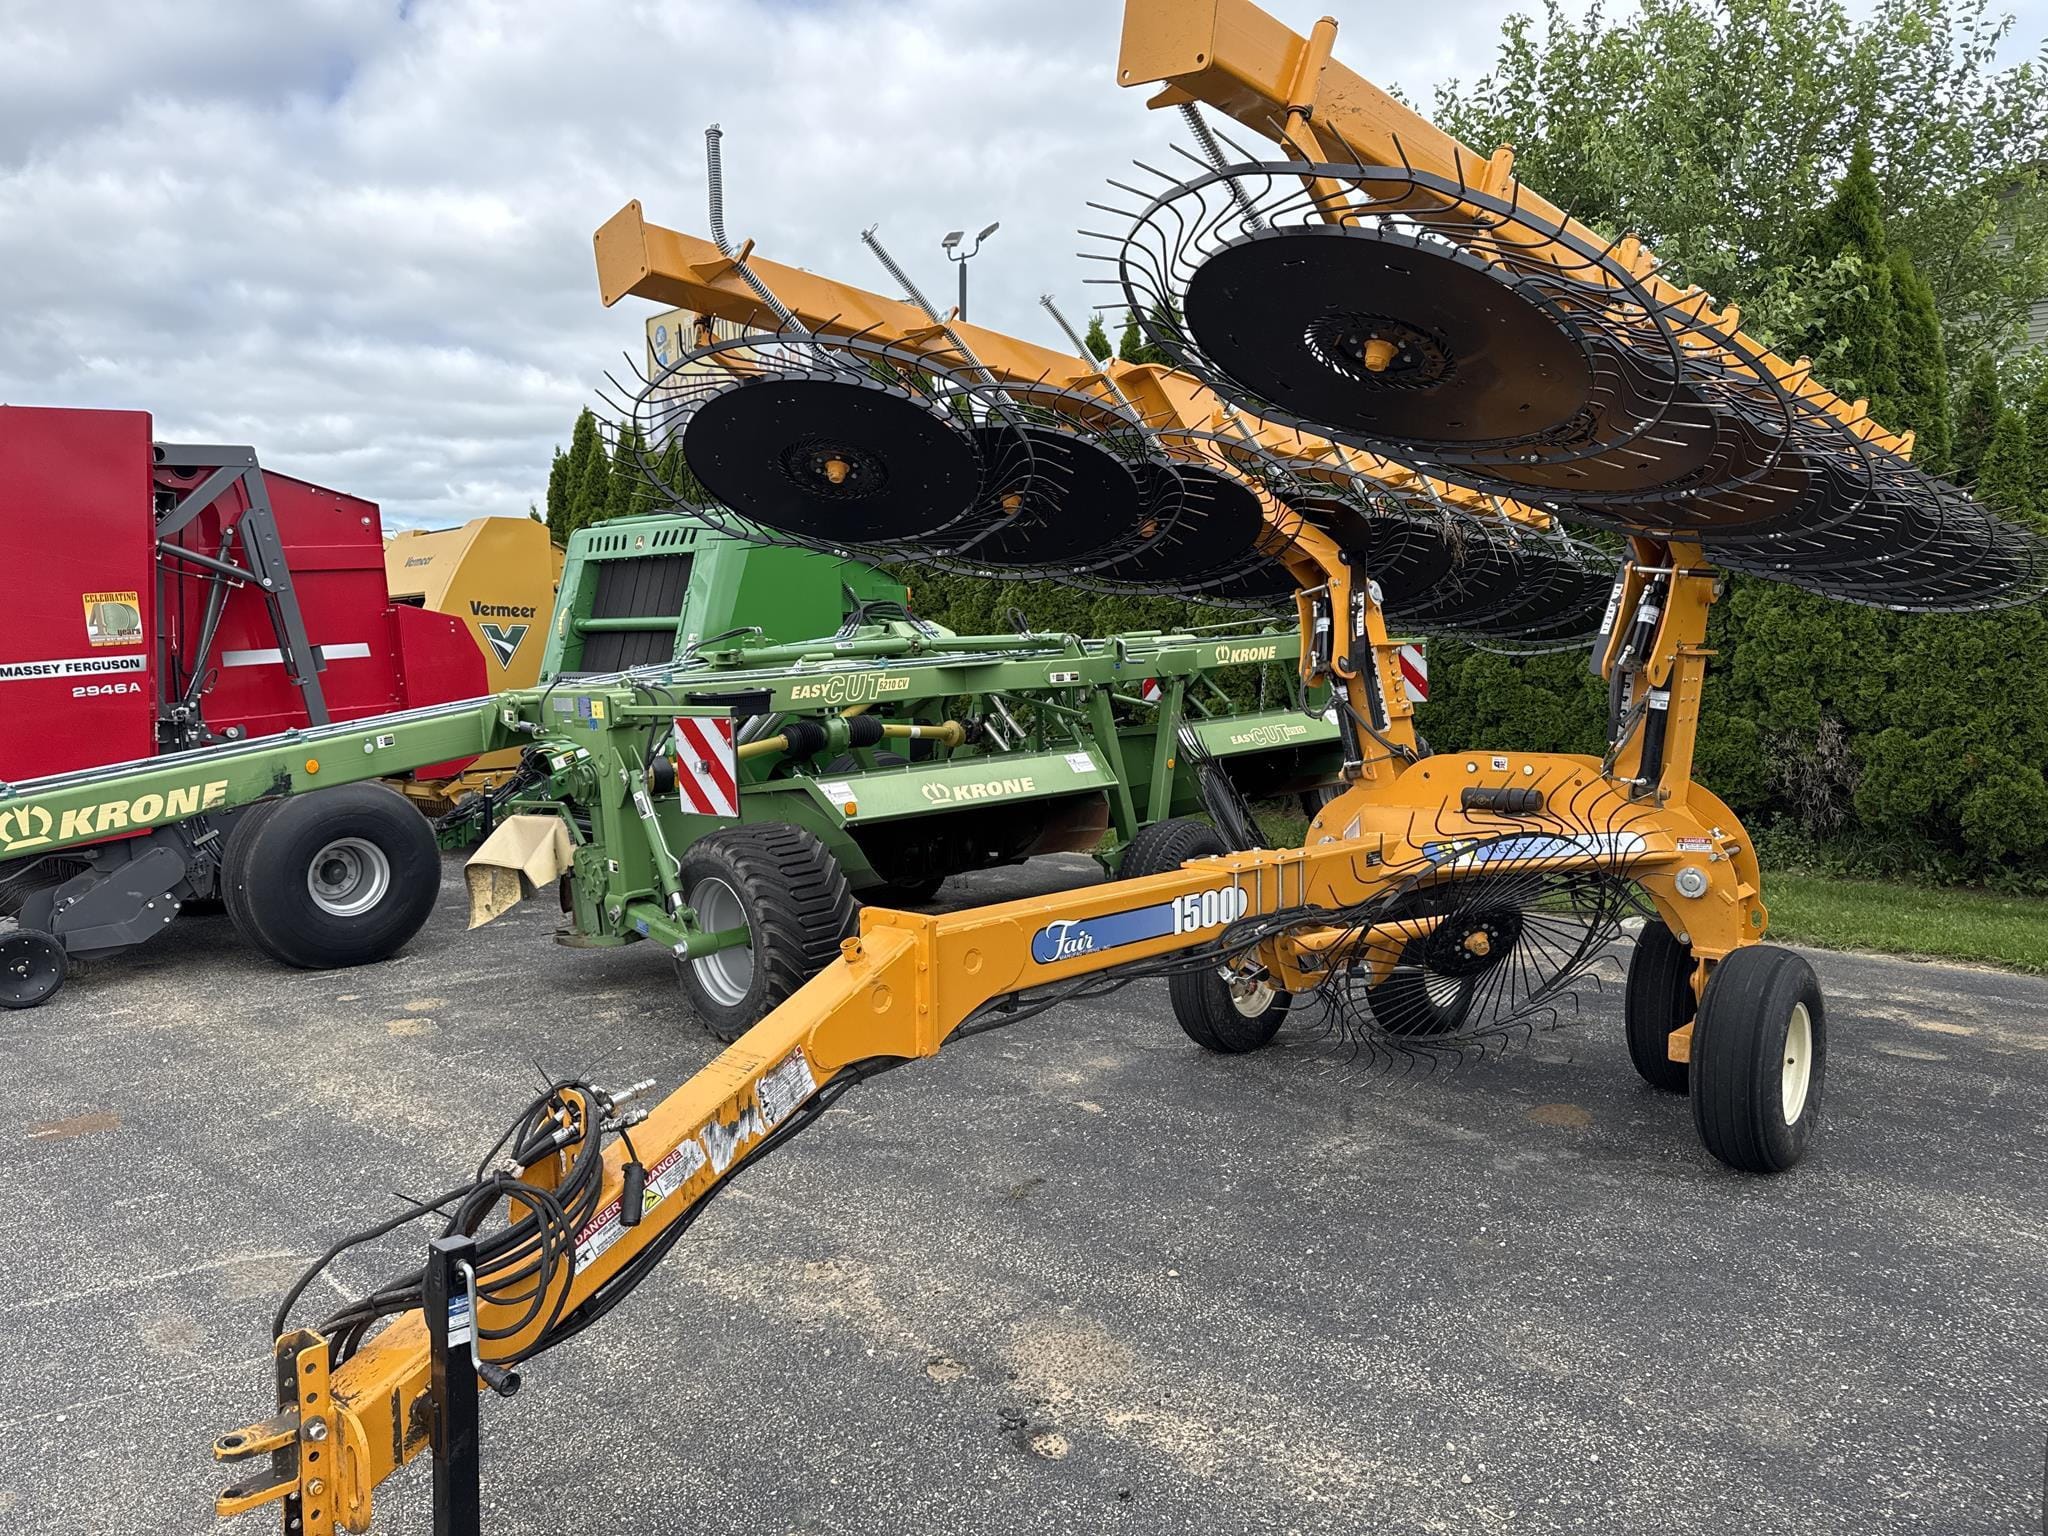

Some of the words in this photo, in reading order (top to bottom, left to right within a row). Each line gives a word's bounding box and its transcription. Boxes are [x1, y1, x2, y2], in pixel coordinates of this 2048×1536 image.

[84, 592, 137, 603] CELEBRATING
[470, 600, 537, 618] Vermeer
[117, 628, 141, 637] years
[1230, 645, 1276, 663] KRONE
[0, 664, 60, 678] MASSEY
[65, 658, 140, 673] FERGUSON
[72, 682, 141, 698] 2946A
[952, 776, 1036, 801] KRONE
[59, 779, 229, 840] KRONE
[1043, 919, 1095, 962] Fair
[1172, 886, 1236, 936] 1500
[574, 1201, 622, 1246] DANGER
